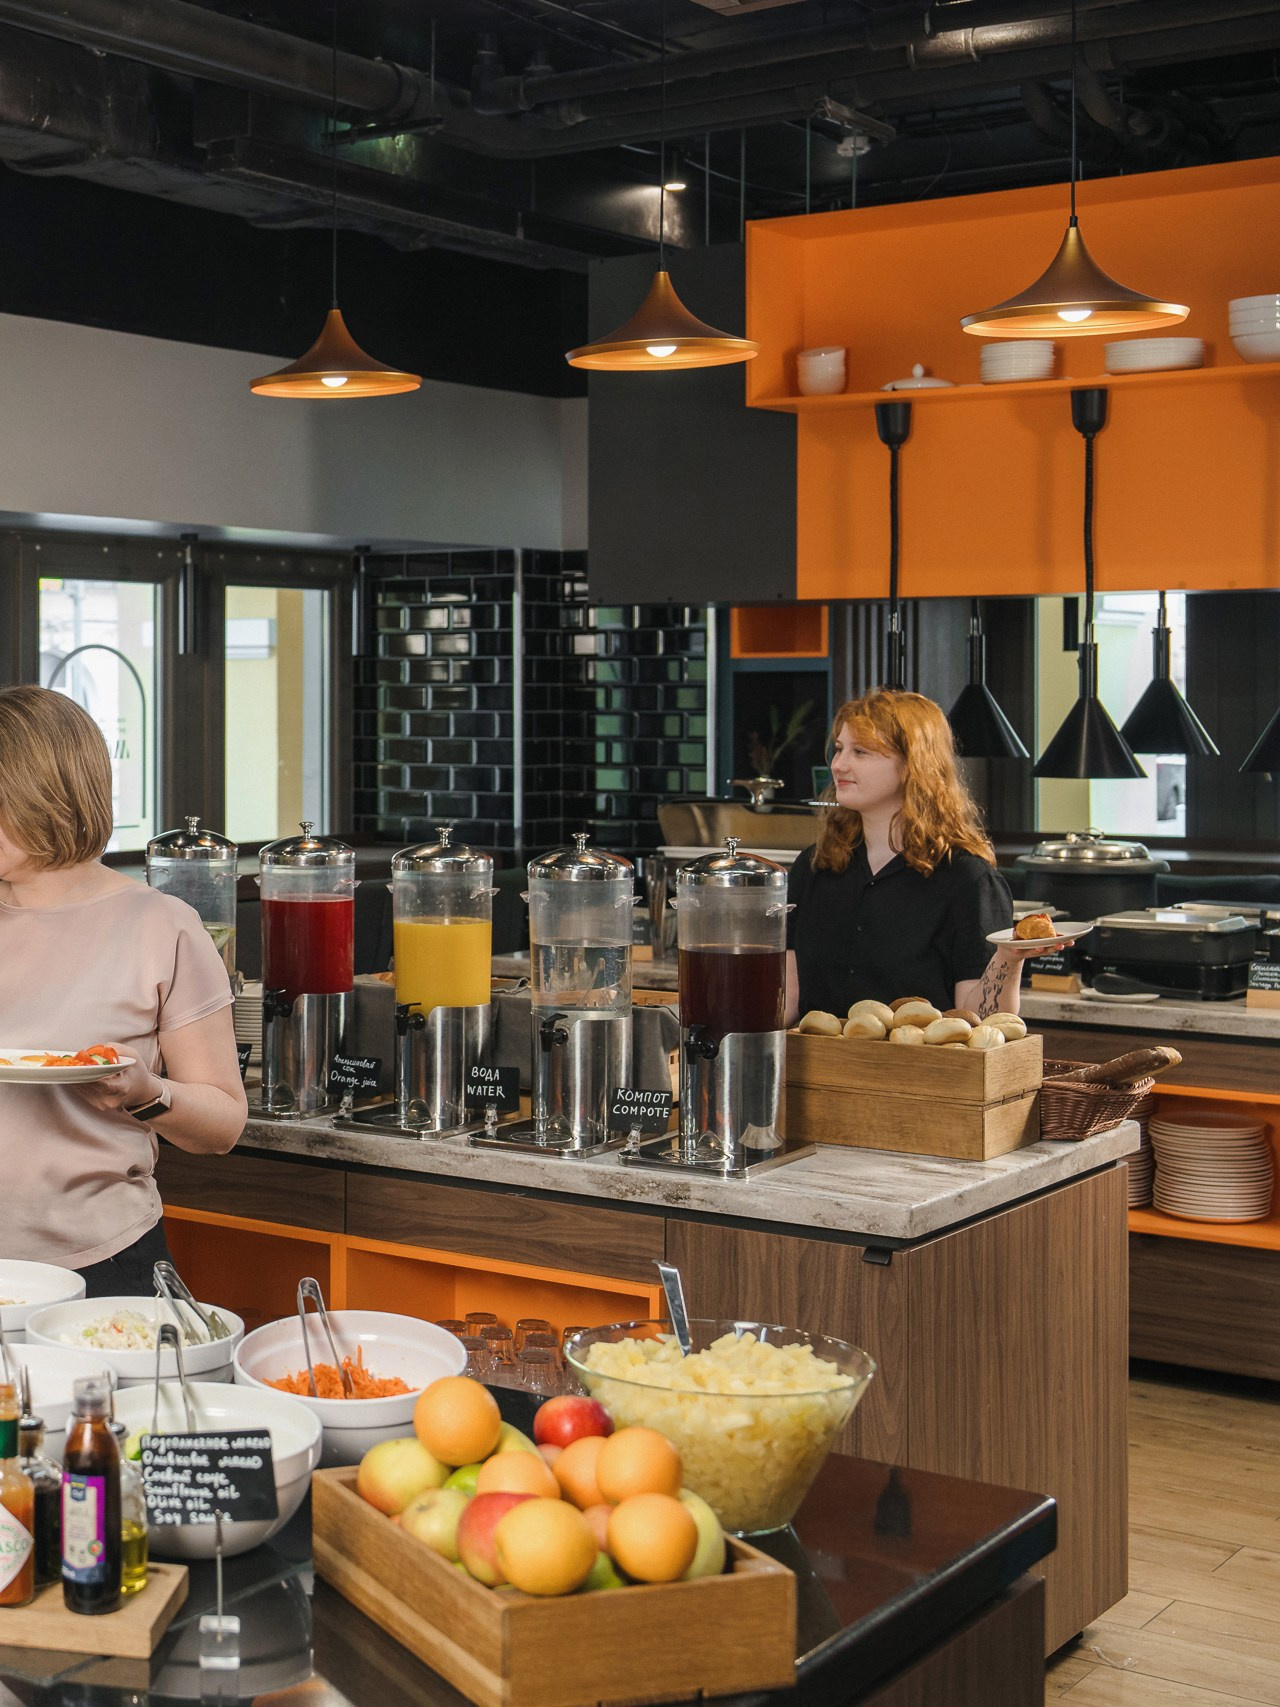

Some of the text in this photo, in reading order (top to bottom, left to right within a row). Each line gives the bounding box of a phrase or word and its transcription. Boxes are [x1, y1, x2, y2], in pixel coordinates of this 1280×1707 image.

[342, 1065, 356, 1073] сок
[471, 1066, 500, 1082] ВОДА
[330, 1070, 377, 1088] Orange juice
[467, 1084, 506, 1099] WATER
[616, 1088, 670, 1105] КОМПОТ
[612, 1103, 670, 1119] COMPOTE
[217, 1484, 240, 1500] oil
[146, 1494, 211, 1511] Olive oil
[153, 1508, 234, 1527] Soy saue
